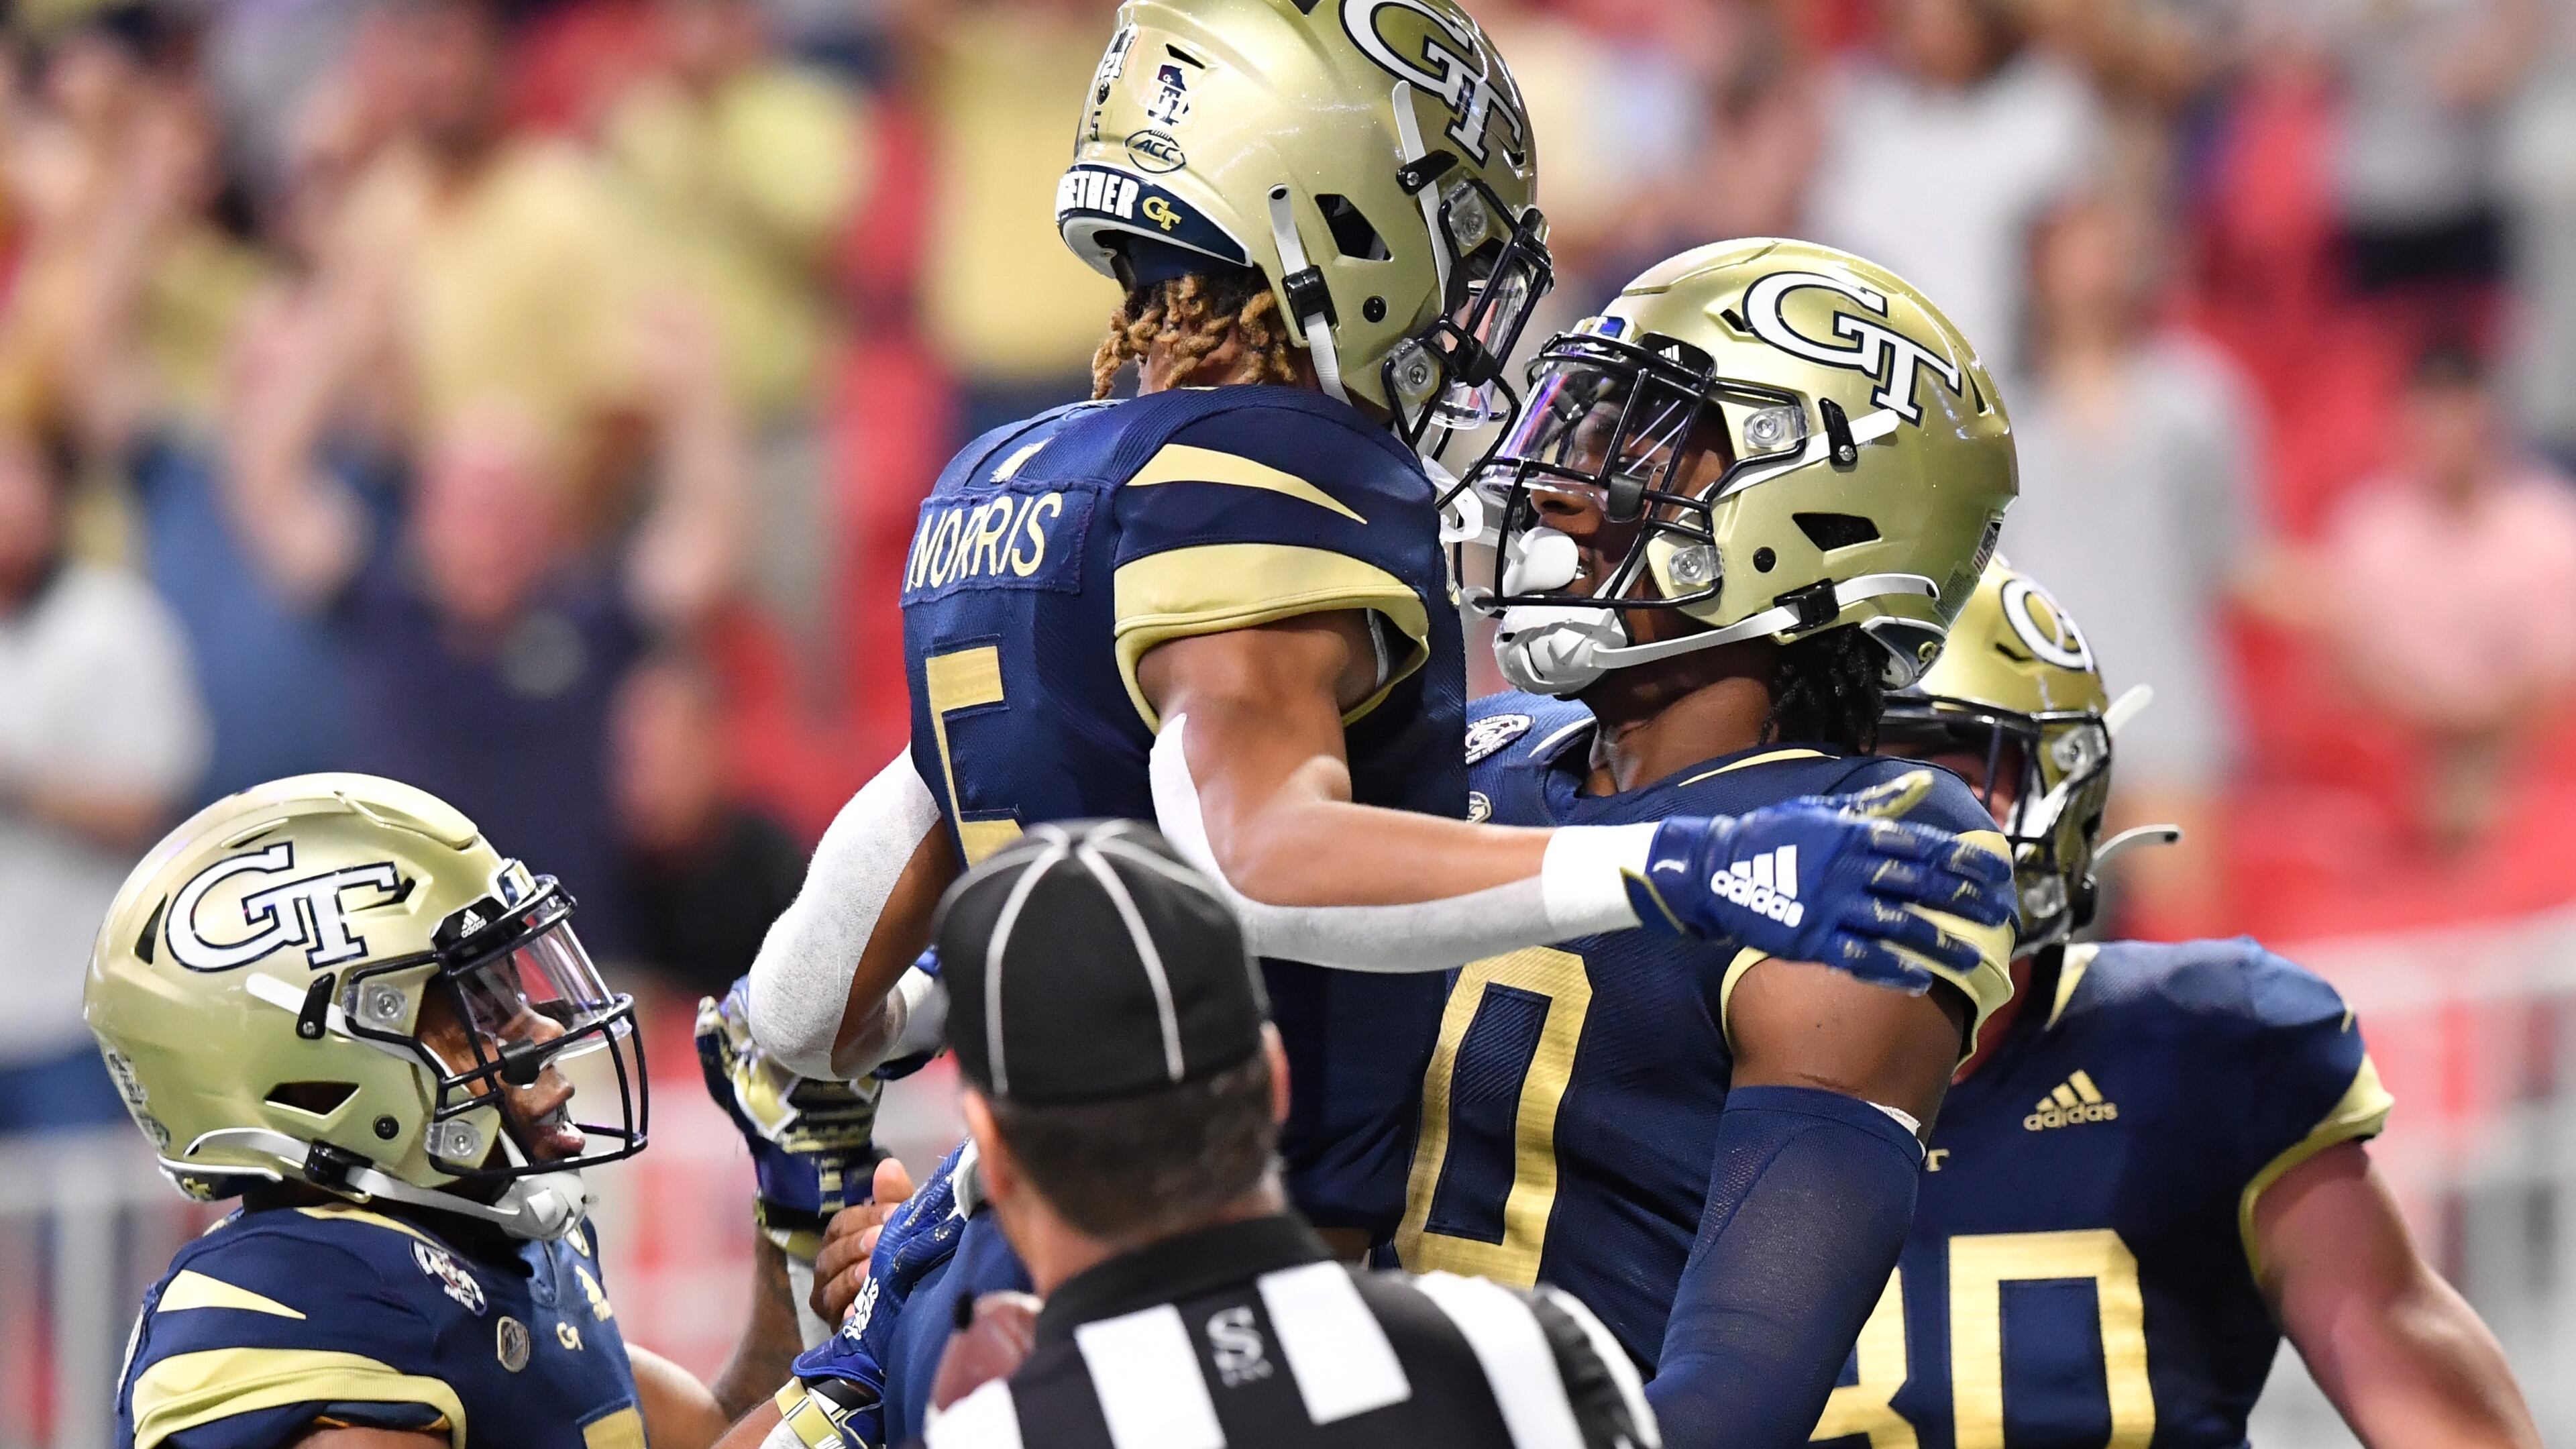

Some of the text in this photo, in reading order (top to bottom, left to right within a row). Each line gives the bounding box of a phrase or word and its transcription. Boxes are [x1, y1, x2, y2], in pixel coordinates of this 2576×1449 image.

[1339, 0, 1523, 168] GT
[1132, 140, 1180, 162] ACC
[1142, 196, 1182, 231] GT
[1742, 270, 1962, 427] GT
[905, 492, 1063, 594] NORRIS
[165, 841, 401, 973] GT
[461, 915, 487, 938] adidas
[1711, 869, 1805, 928] adidas
[2023, 1102, 2118, 1132] adidas
